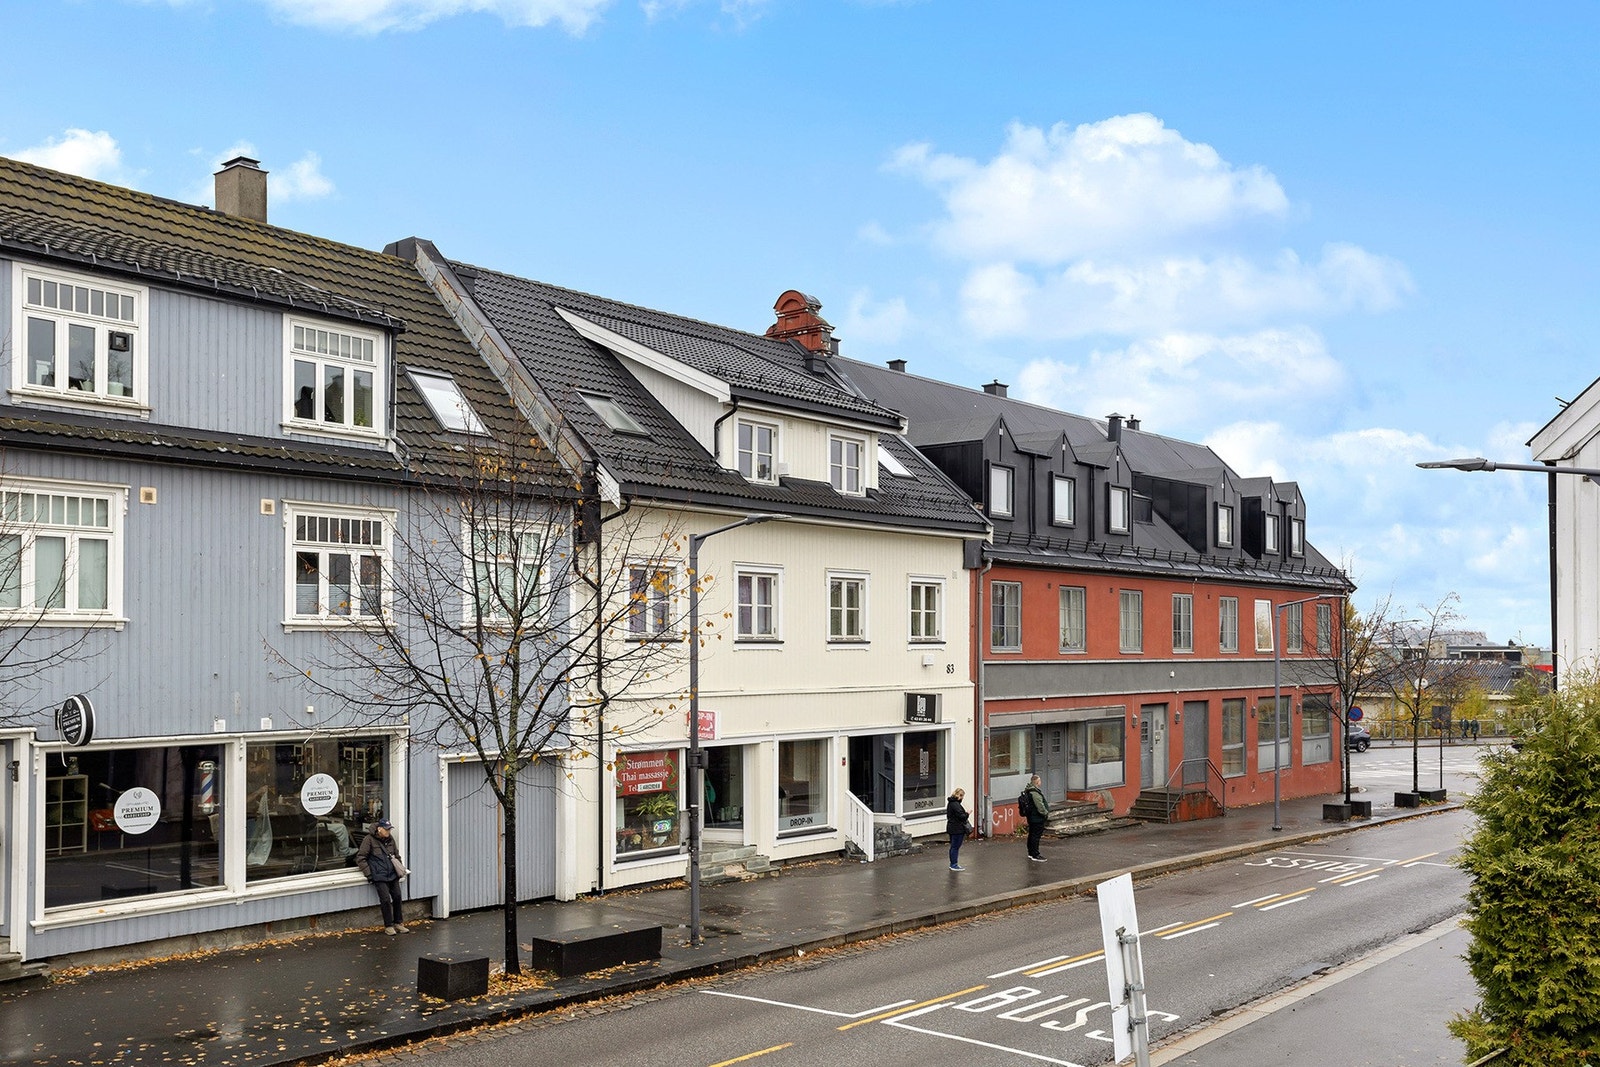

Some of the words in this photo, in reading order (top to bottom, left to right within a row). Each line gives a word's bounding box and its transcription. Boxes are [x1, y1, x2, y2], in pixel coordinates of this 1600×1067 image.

[946, 663, 955, 674] 83
[626, 759, 664, 770] Strømmen
[621, 771, 637, 782] Thai
[121, 805, 154, 814] PREMIUM
[914, 800, 934, 809] DROP-IN
[790, 816, 814, 827] DROP-IN
[1244, 856, 1369, 873] BUSS
